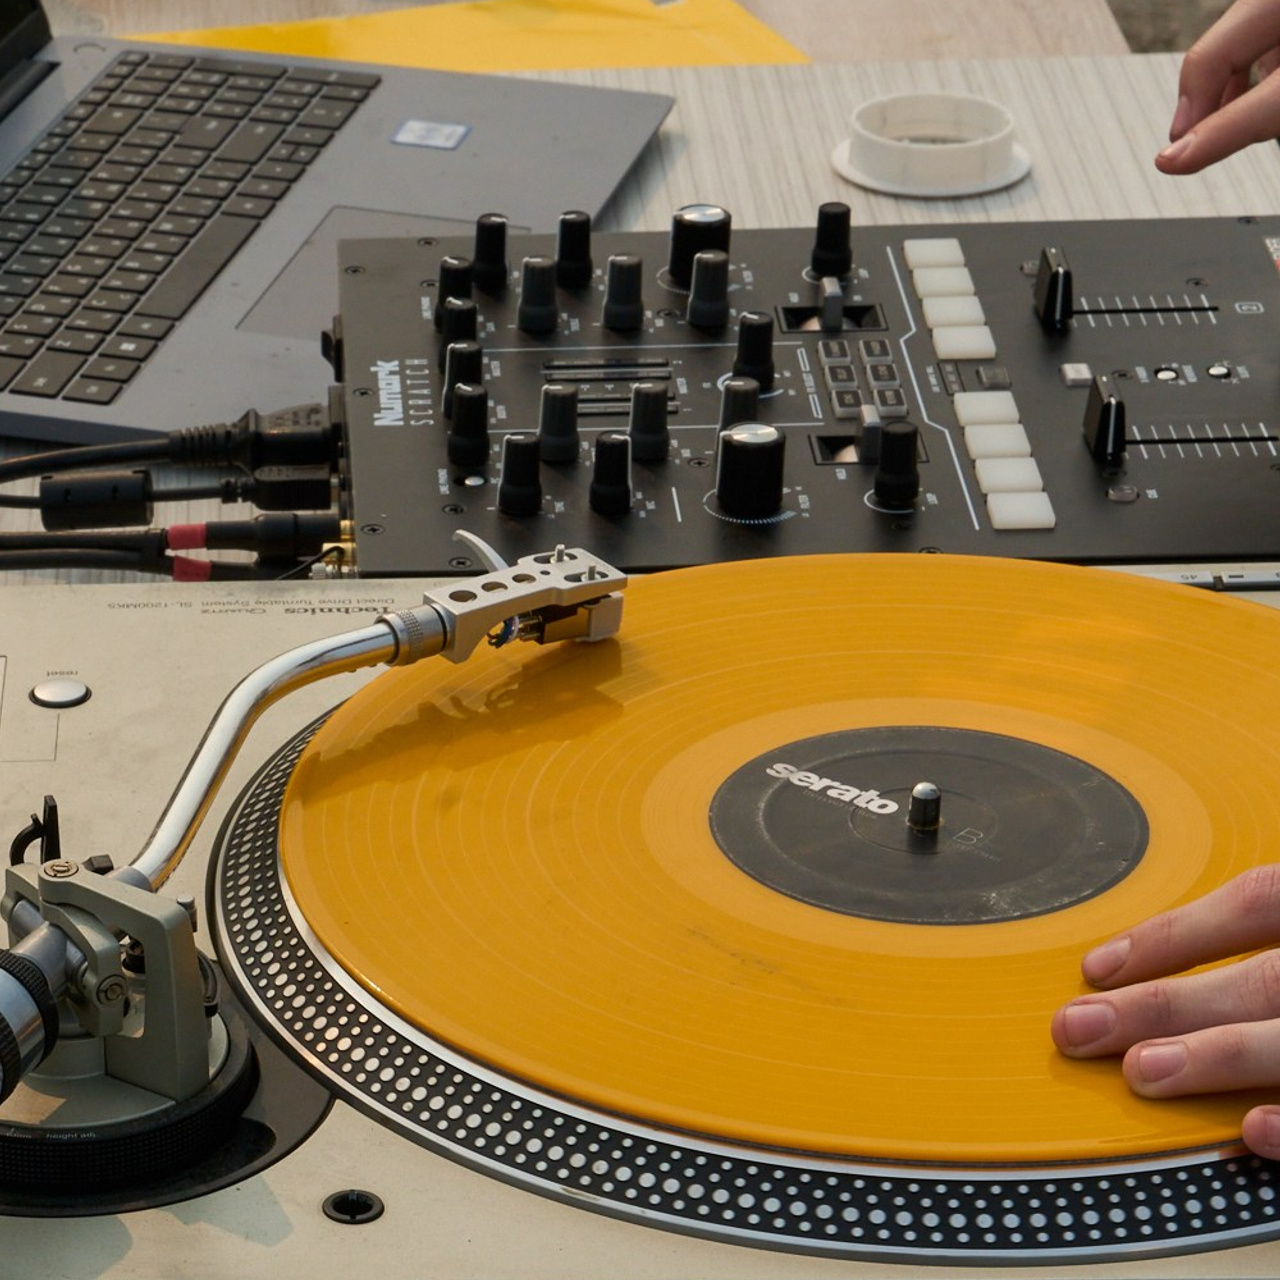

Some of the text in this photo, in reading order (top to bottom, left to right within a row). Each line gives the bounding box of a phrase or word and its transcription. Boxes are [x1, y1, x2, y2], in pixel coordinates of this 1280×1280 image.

[370, 360, 404, 427] Numark
[404, 358, 435, 425] SCRATCH
[200, 599, 250, 608] System
[254, 599, 314, 607] Turntable
[318, 598, 352, 606] Drive
[356, 597, 395, 605] Direct
[284, 606, 394, 616] Technics
[765, 763, 899, 814] serato
